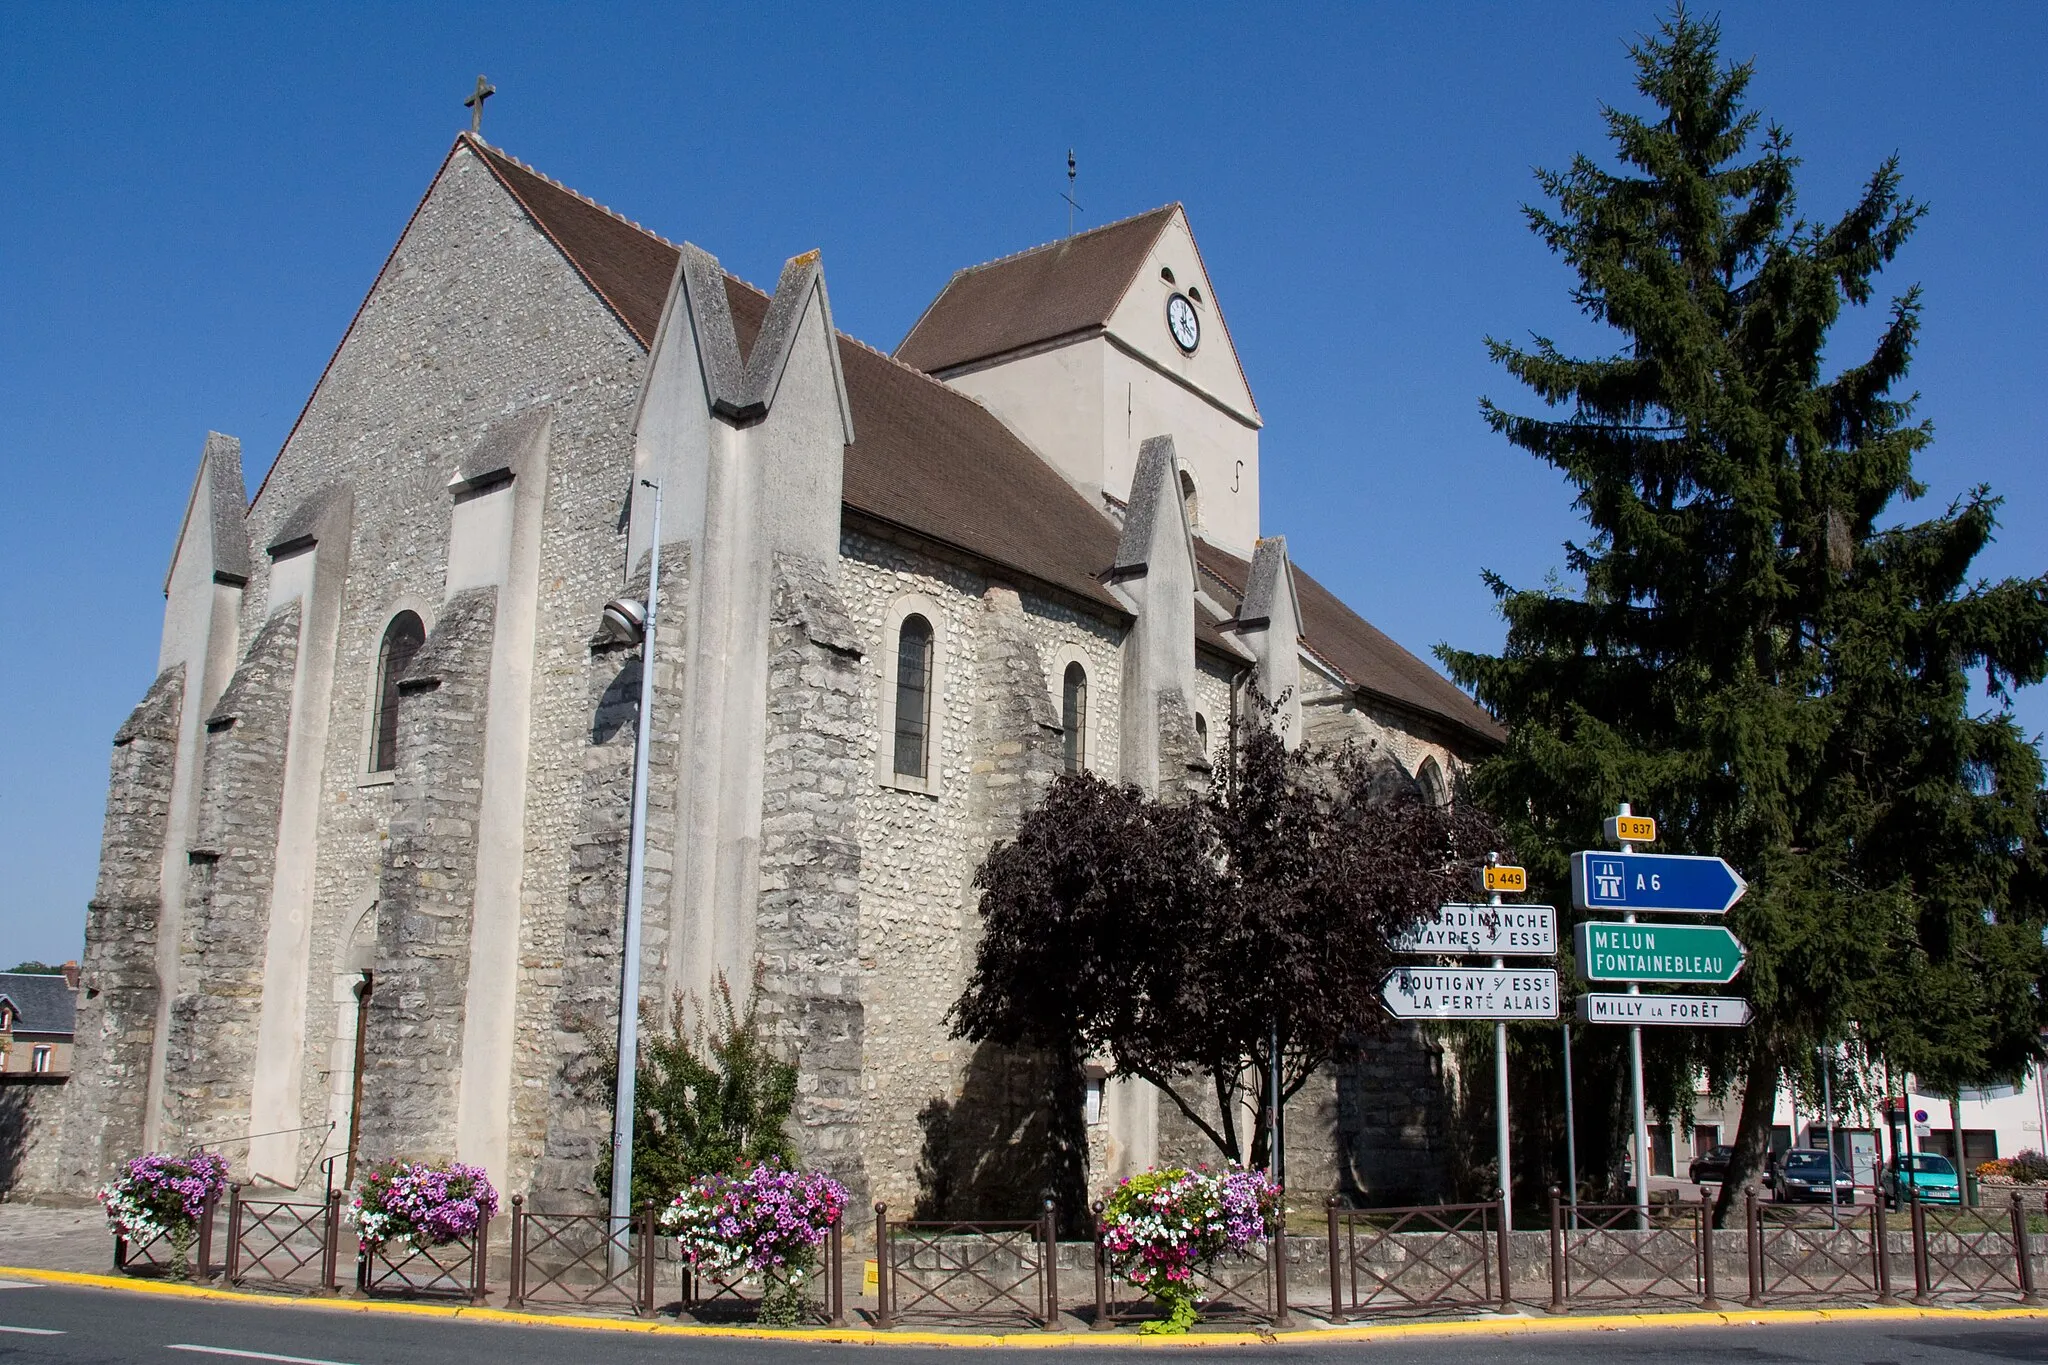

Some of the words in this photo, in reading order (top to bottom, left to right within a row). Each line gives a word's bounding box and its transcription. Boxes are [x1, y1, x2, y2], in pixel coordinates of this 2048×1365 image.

[1620, 822, 1628, 833] D
[1632, 823, 1651, 834] 837
[1488, 873, 1495, 884] D
[1500, 873, 1521, 884] 449
[1415, 931, 1481, 945] VAYRES
[1595, 932, 1655, 950] MELUN
[1596, 954, 1722, 974] FONTAINEBLEAU
[1400, 976, 1485, 991] BOUTIGNY
[1413, 996, 1432, 1009] LA
[1442, 993, 1494, 1010] FERTÉ
[1503, 996, 1551, 1010] ALAIS
[1596, 1002, 1642, 1016] MILLY
[1651, 1007, 1663, 1017] LA
[1670, 1002, 1719, 1018] FORÊT
